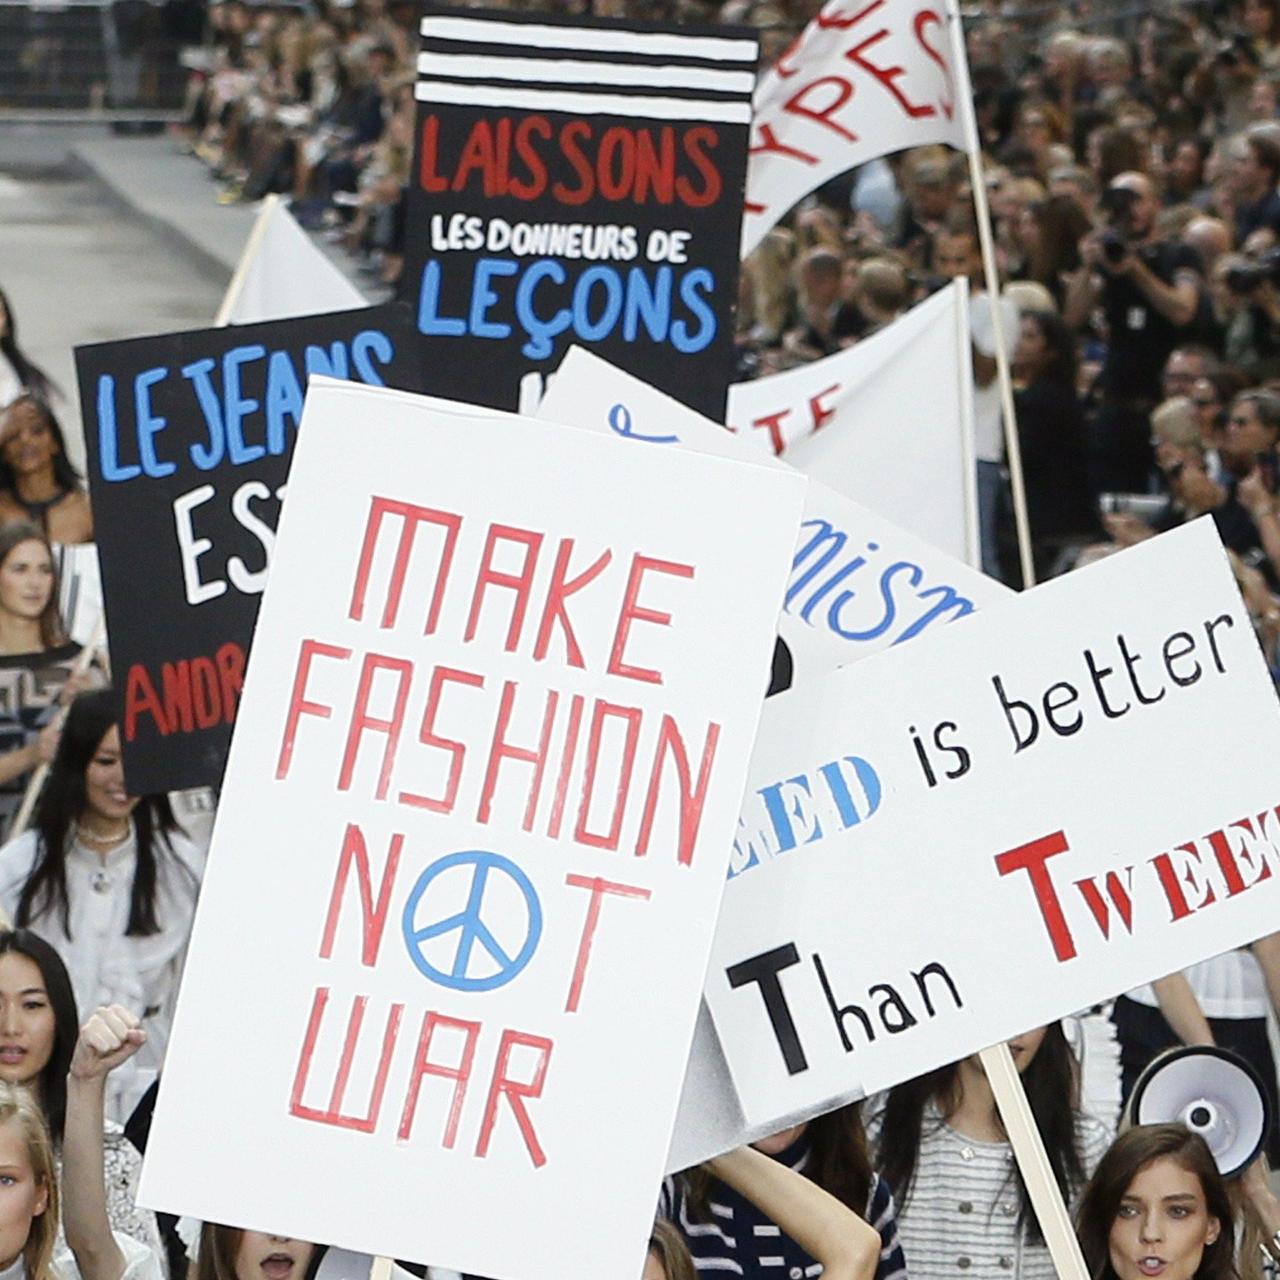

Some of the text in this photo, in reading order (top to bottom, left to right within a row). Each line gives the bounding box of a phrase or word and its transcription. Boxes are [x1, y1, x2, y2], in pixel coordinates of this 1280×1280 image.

[418, 115, 722, 208] LAISSONS
[431, 214, 690, 264] LES DONNEURS DE
[418, 260, 717, 360] LEÇONS
[97, 367, 178, 483] LE
[173, 481, 287, 604] ES
[349, 495, 695, 685] MAKE
[275, 638, 721, 868] FASHION
[909, 721, 971, 788] is
[992, 612, 1234, 755] better
[724, 941, 964, 1076] Than
[288, 987, 555, 1168] WAR
